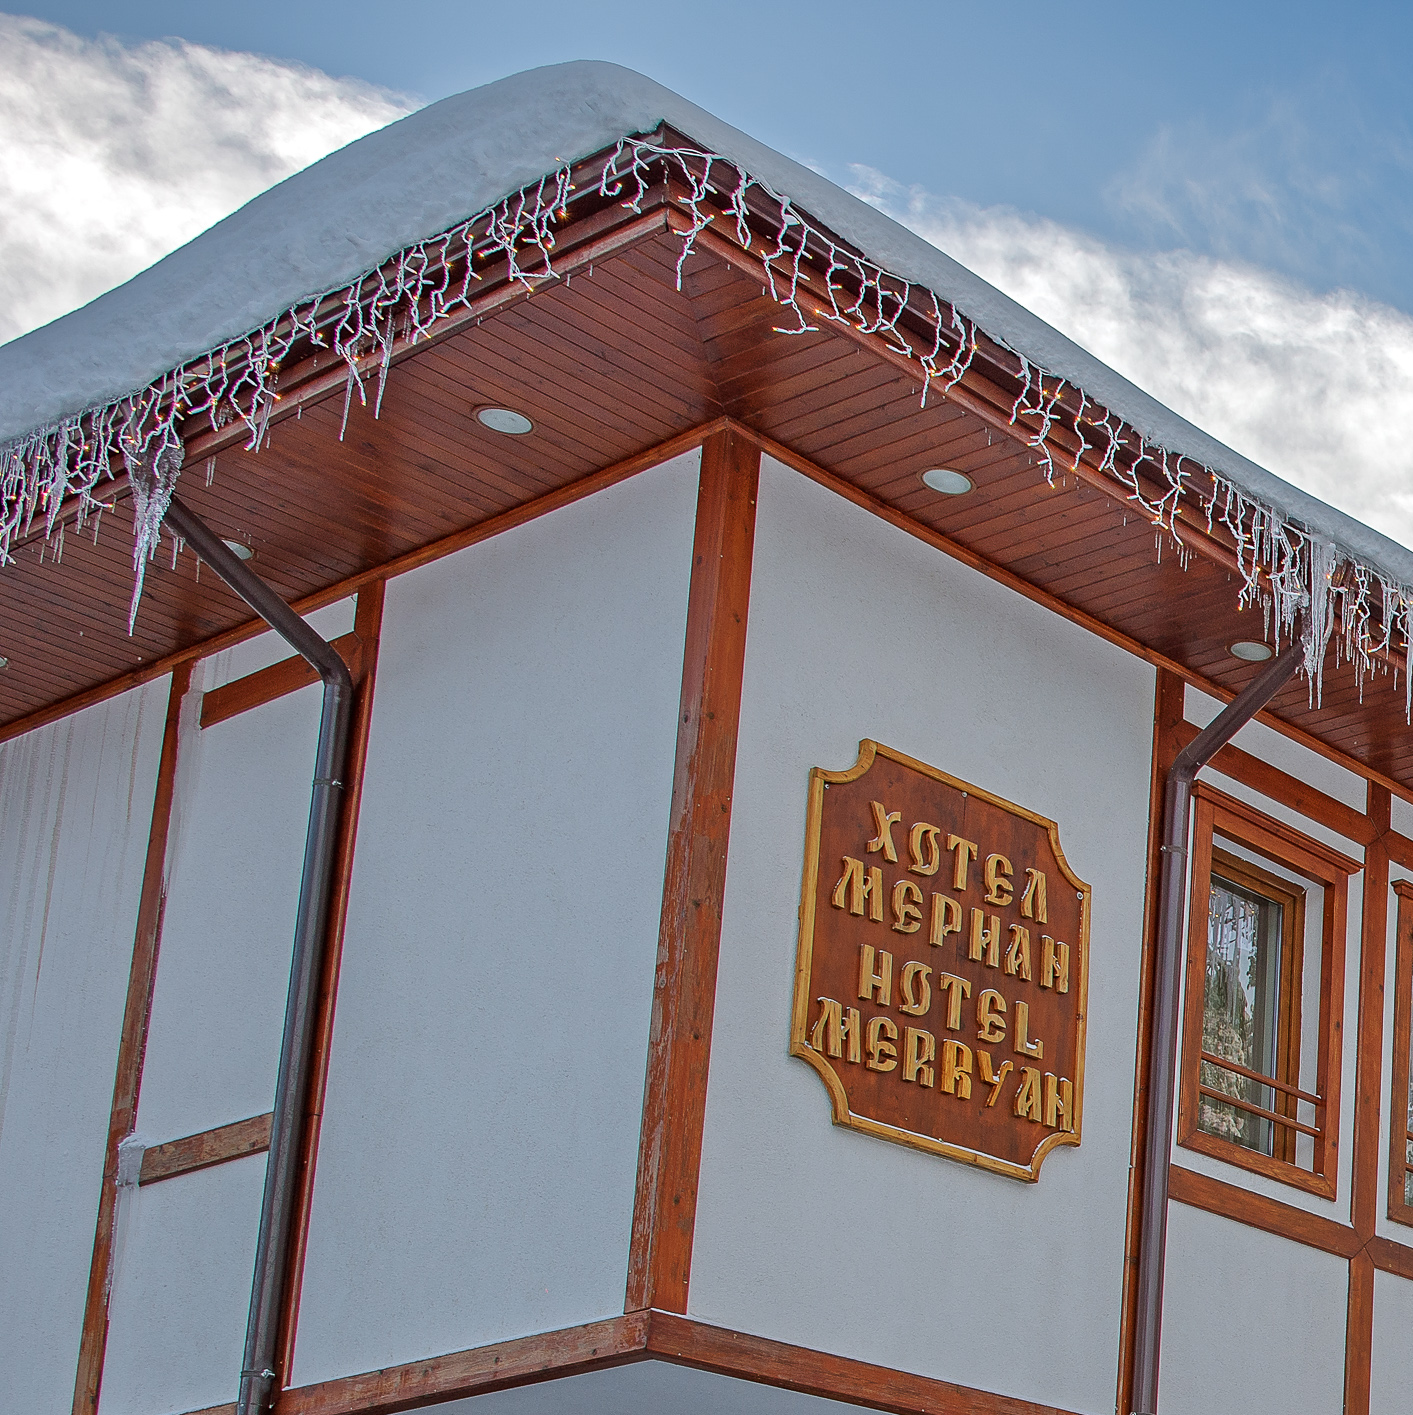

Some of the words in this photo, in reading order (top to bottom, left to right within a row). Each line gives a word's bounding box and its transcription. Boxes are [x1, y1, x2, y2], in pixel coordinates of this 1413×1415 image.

[868, 801, 1047, 924] ХОТЕЛ
[858, 943, 1043, 1060] HOTEL
[810, 996, 1073, 1132] MERRYAN
